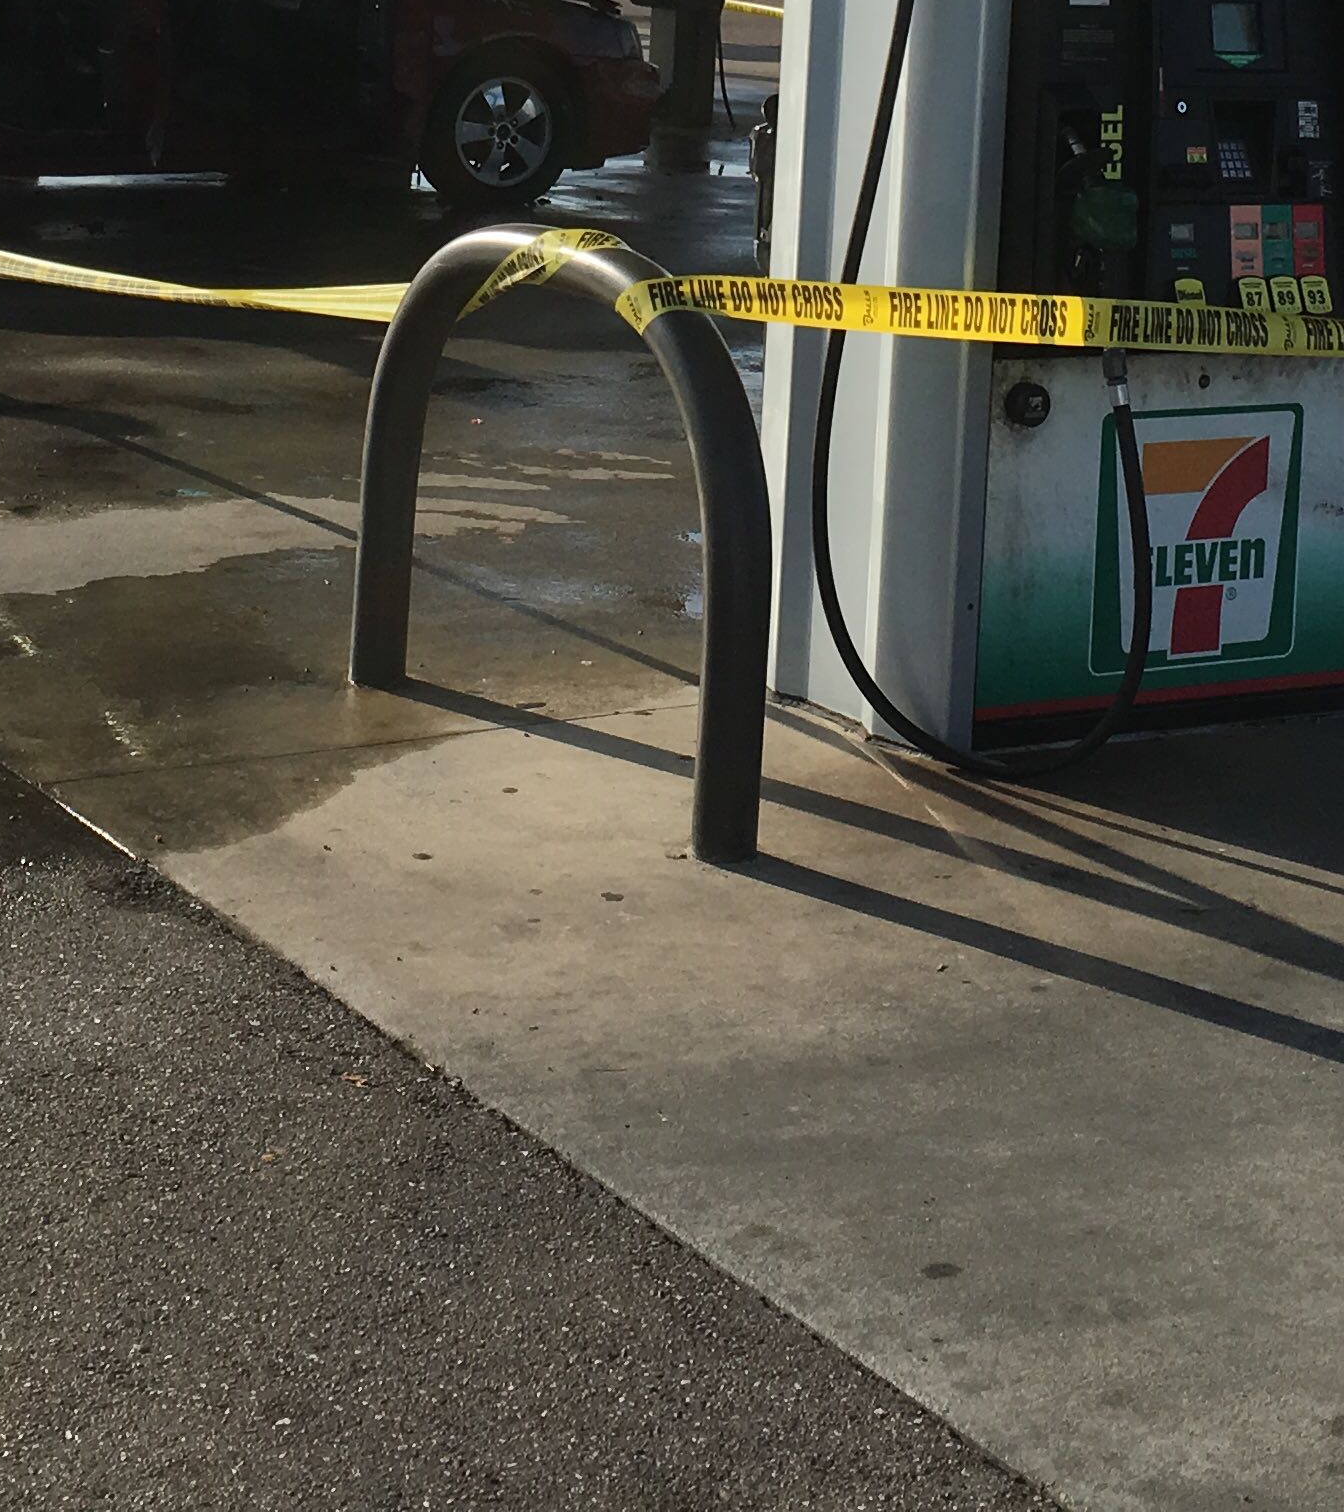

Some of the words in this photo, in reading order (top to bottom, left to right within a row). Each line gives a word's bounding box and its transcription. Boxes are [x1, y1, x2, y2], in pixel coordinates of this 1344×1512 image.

[647, 279, 686, 312] FIRE
[690, 280, 727, 312] LINE
[729, 280, 754, 313] DO
[756, 282, 787, 317] NOT
[792, 284, 844, 321] CROSS
[888, 291, 922, 328] FIRE
[926, 293, 959, 331] LINE
[963, 295, 984, 333] DO
[987, 296, 1017, 334] NOT
[1020, 298, 1068, 337] CROSS
[1245, 291, 1263, 307] 87
[1277, 290, 1296, 306] 89
[1308, 289, 1326, 305] 93
[1109, 305, 1141, 342] FIRE
[1143, 306, 1172, 344] LINE
[1176, 307, 1195, 345] DO
[1198, 308, 1222, 346] NOT
[1225, 310, 1269, 348] CROSS
[1303, 316, 1333, 351] FIRE
[1149, 538, 1265, 588] LEVEN
